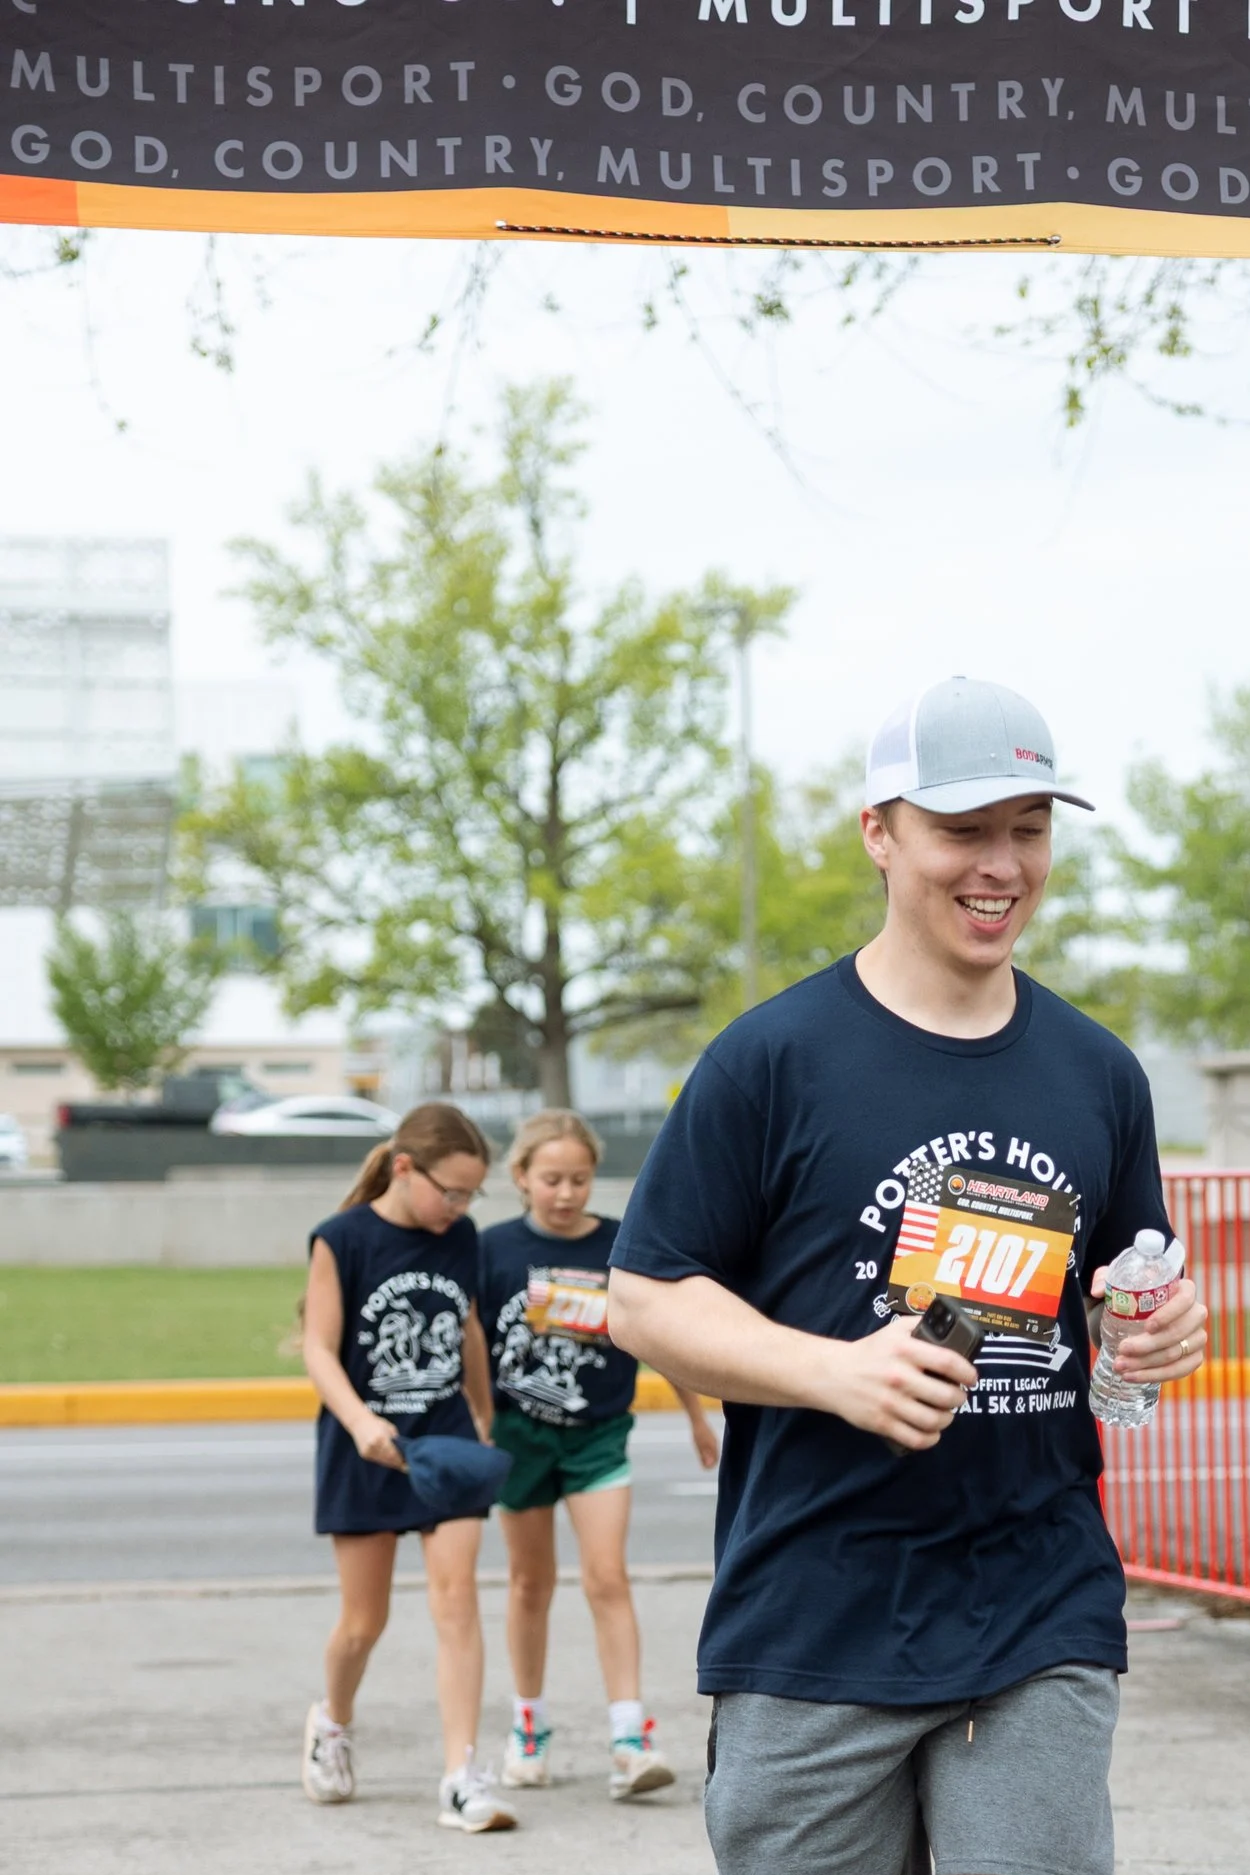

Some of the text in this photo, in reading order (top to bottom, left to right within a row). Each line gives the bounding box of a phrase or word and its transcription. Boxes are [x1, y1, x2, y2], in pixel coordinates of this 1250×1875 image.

[10, 48, 476, 107] MULTISPORT
[544, 64, 704, 123] GOD,
[736, 77, 1075, 126] COUNTRY,
[10, 124, 180, 179] GOD,
[214, 134, 565, 182] COUNTRY,
[596, 145, 1042, 198] MULTISPORT
[859, 1131, 996, 1233] POTTER'S
[966, 1179, 1050, 1208] HEARTLAND
[855, 1260, 878, 1280] 20
[934, 1224, 1049, 1299] 2107
[960, 1377, 1050, 1391] OFFITT LEGACY
[988, 1395, 1011, 1414] 5K
[1015, 1396, 1026, 1413] &
[1029, 1392, 1052, 1413] FUN
[1053, 1390, 1076, 1409] RUN
